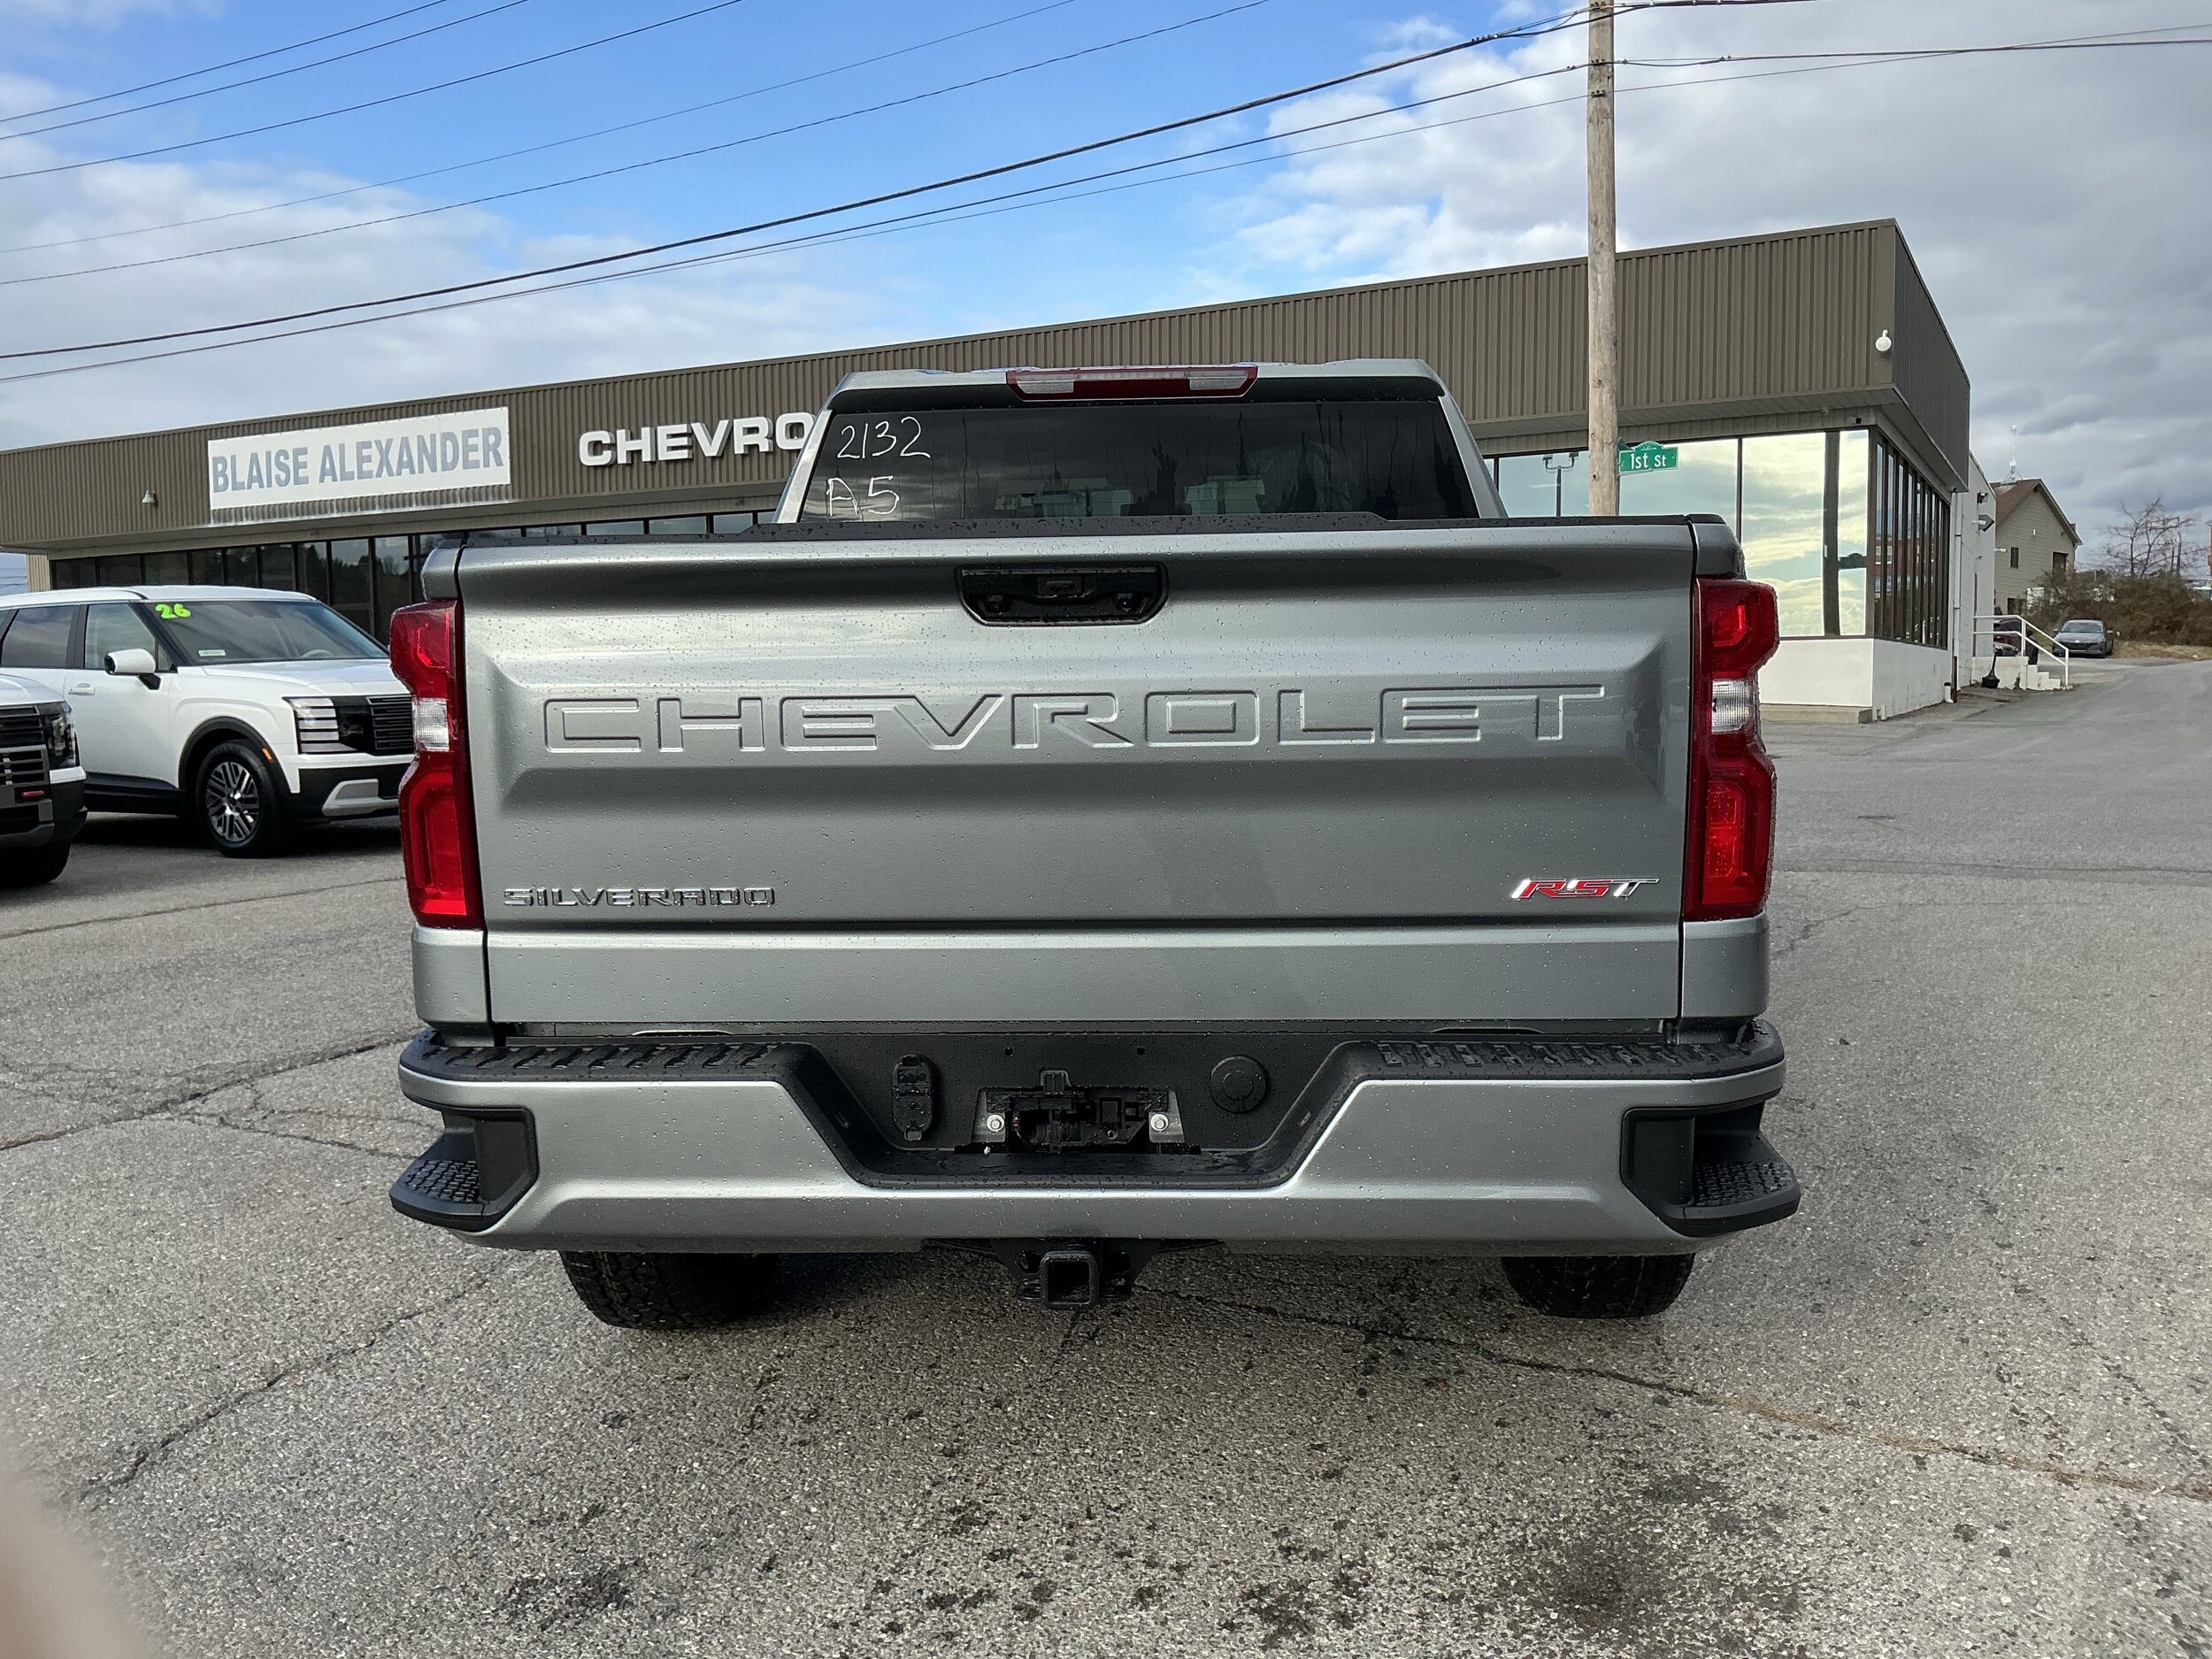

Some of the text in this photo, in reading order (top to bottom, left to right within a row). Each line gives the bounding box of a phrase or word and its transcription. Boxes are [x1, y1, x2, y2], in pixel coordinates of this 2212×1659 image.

[211, 426, 504, 494] BLAISE ALEXANDER
[578, 411, 818, 466] CHEVRO
[836, 416, 932, 461] 2132
[1630, 452, 1666, 470] 1st St
[826, 475, 901, 519] A5
[155, 603, 192, 619] 26
[543, 685, 1607, 754] CHEVROLET
[503, 887, 776, 908] SILVERADO
[1510, 878, 1661, 900] RST
